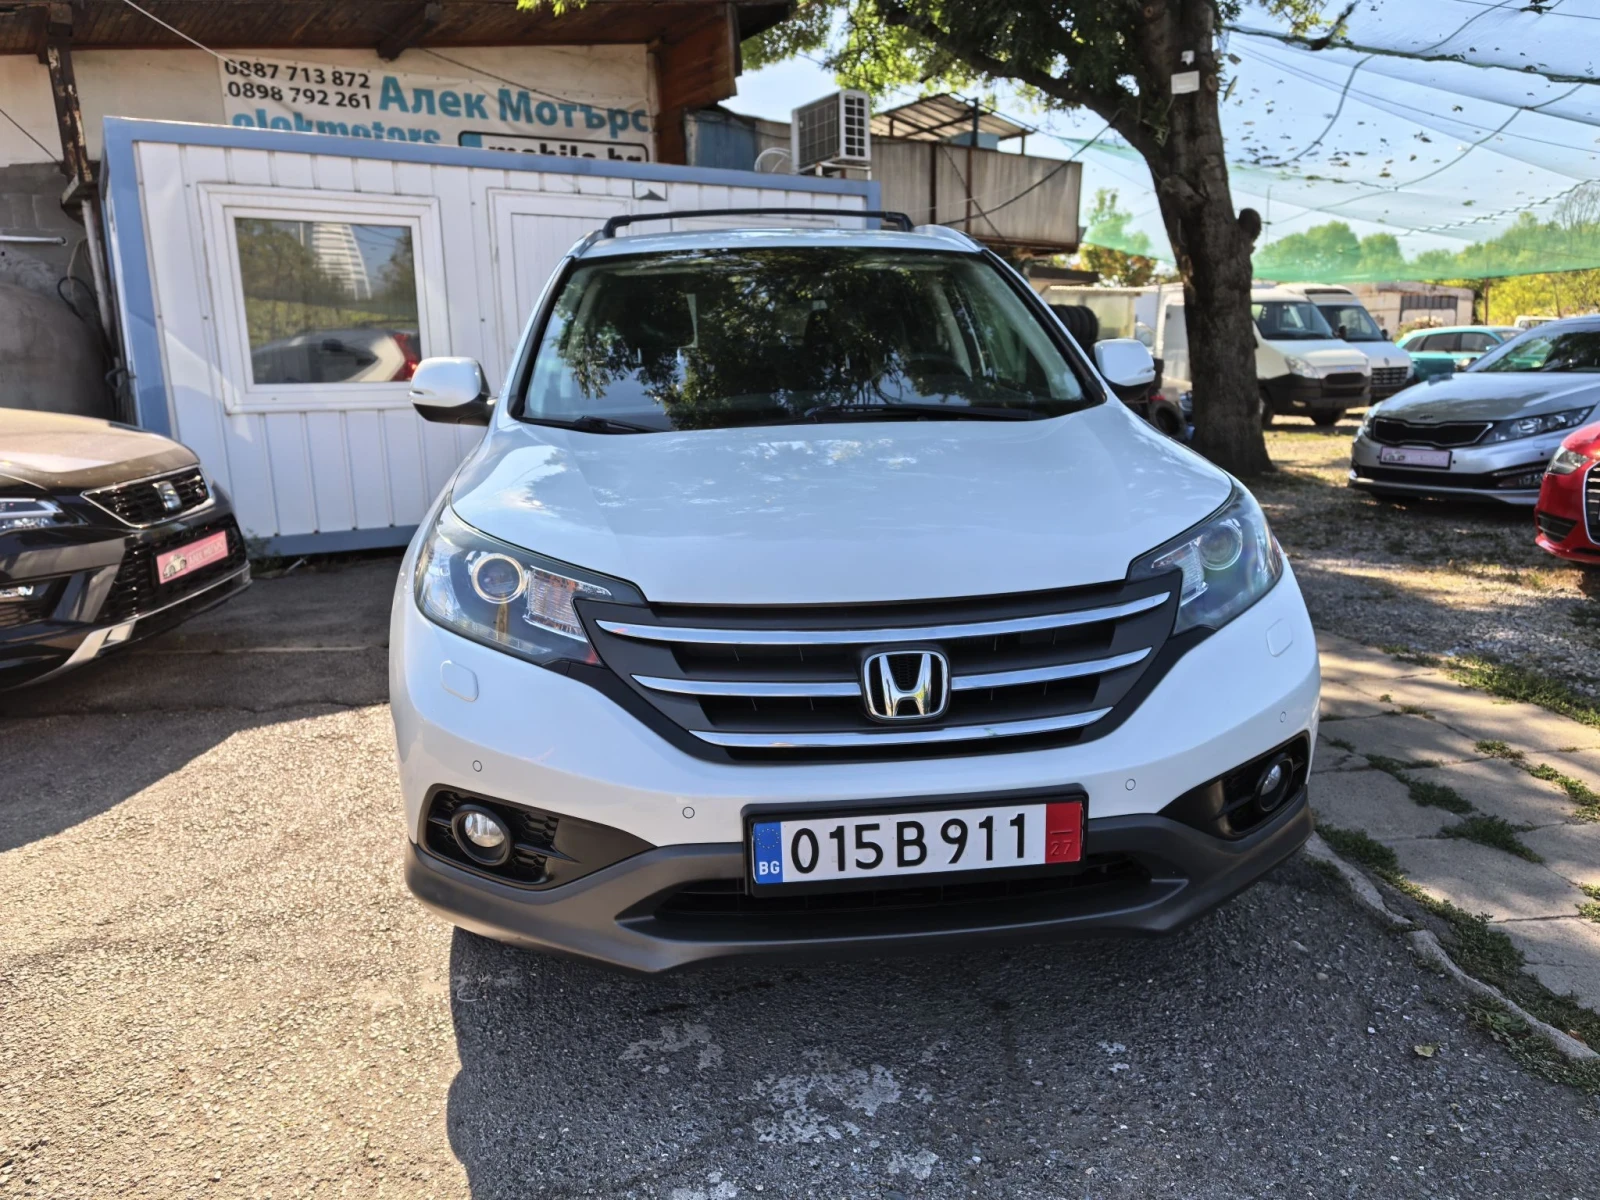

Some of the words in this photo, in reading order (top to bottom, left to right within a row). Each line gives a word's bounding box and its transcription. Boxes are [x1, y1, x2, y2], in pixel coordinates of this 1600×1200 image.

[225, 59, 279, 79] 0887
[286, 65, 326, 84] 713
[332, 70, 371, 89] 872
[228, 81, 283, 102] 0898
[289, 87, 330, 106] 792
[335, 91, 371, 110] 261
[378, 75, 489, 120] Алек
[498, 87, 649, 139] Мотърс
[1051, 839, 1073, 856] 27
[759, 861, 780, 875] BG
